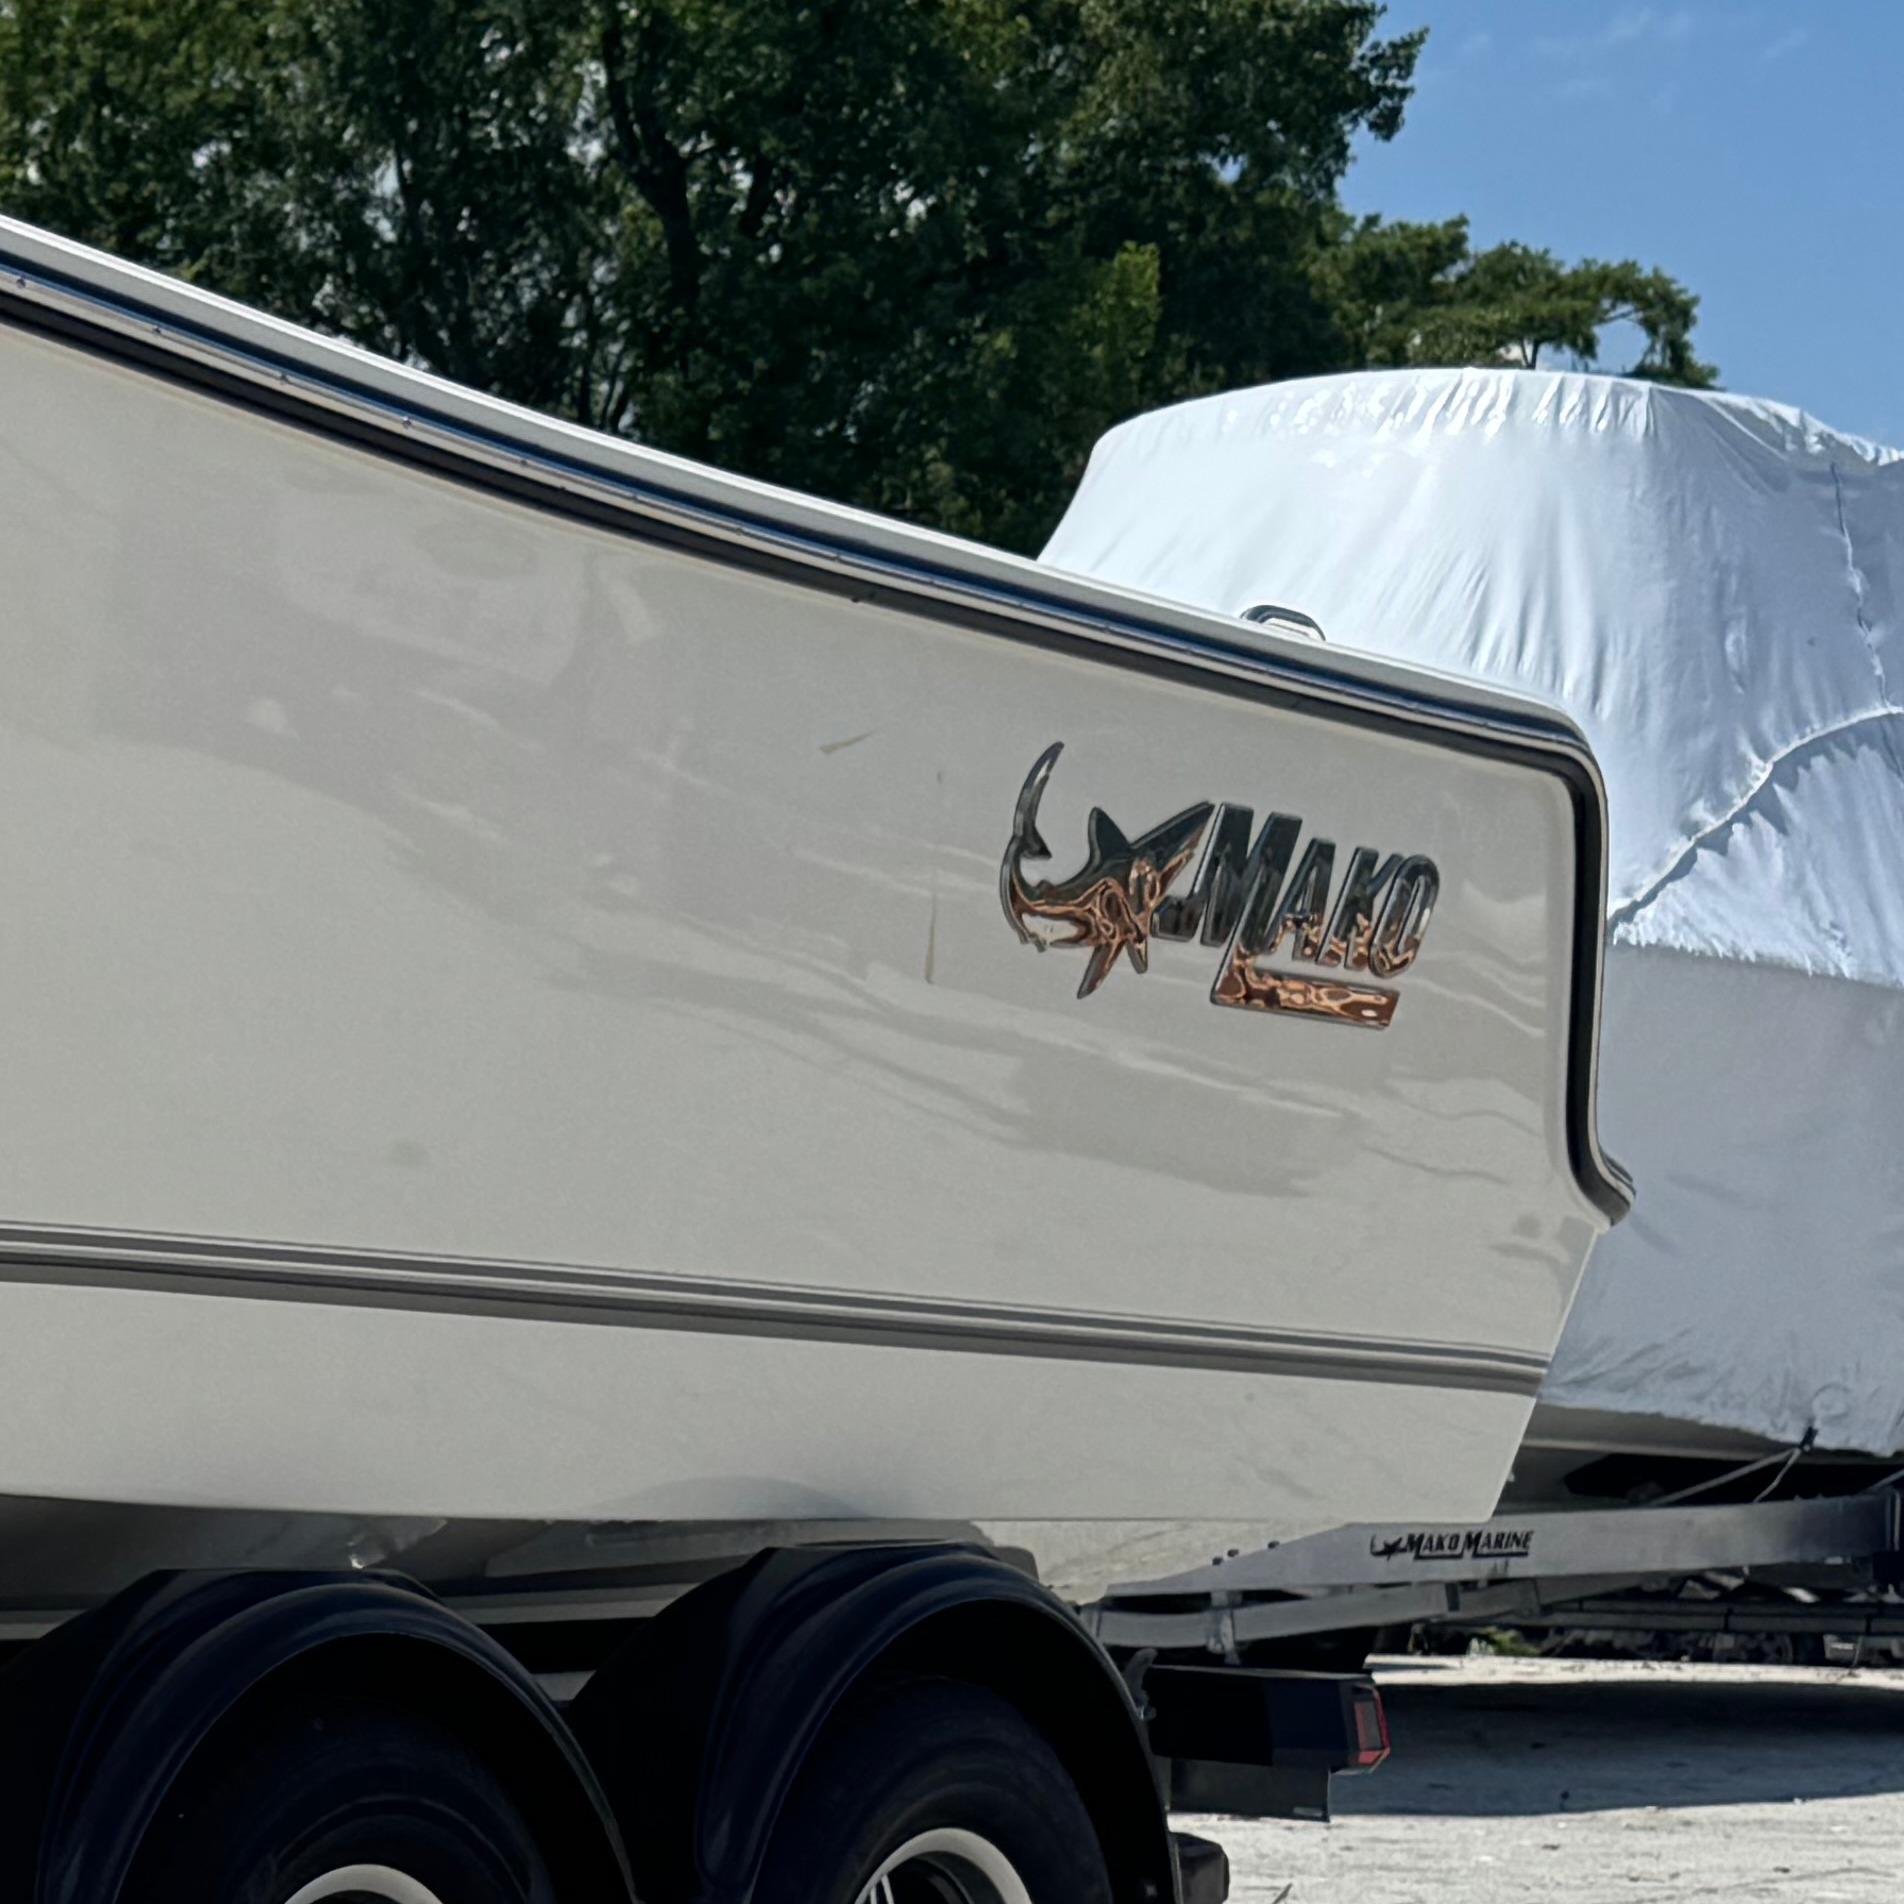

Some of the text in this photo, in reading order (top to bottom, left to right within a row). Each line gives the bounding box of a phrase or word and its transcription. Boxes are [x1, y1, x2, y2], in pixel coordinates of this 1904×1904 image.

[1151, 801, 1442, 1028] MAKO
[1403, 1531, 1534, 1560] MAKO MARINE
